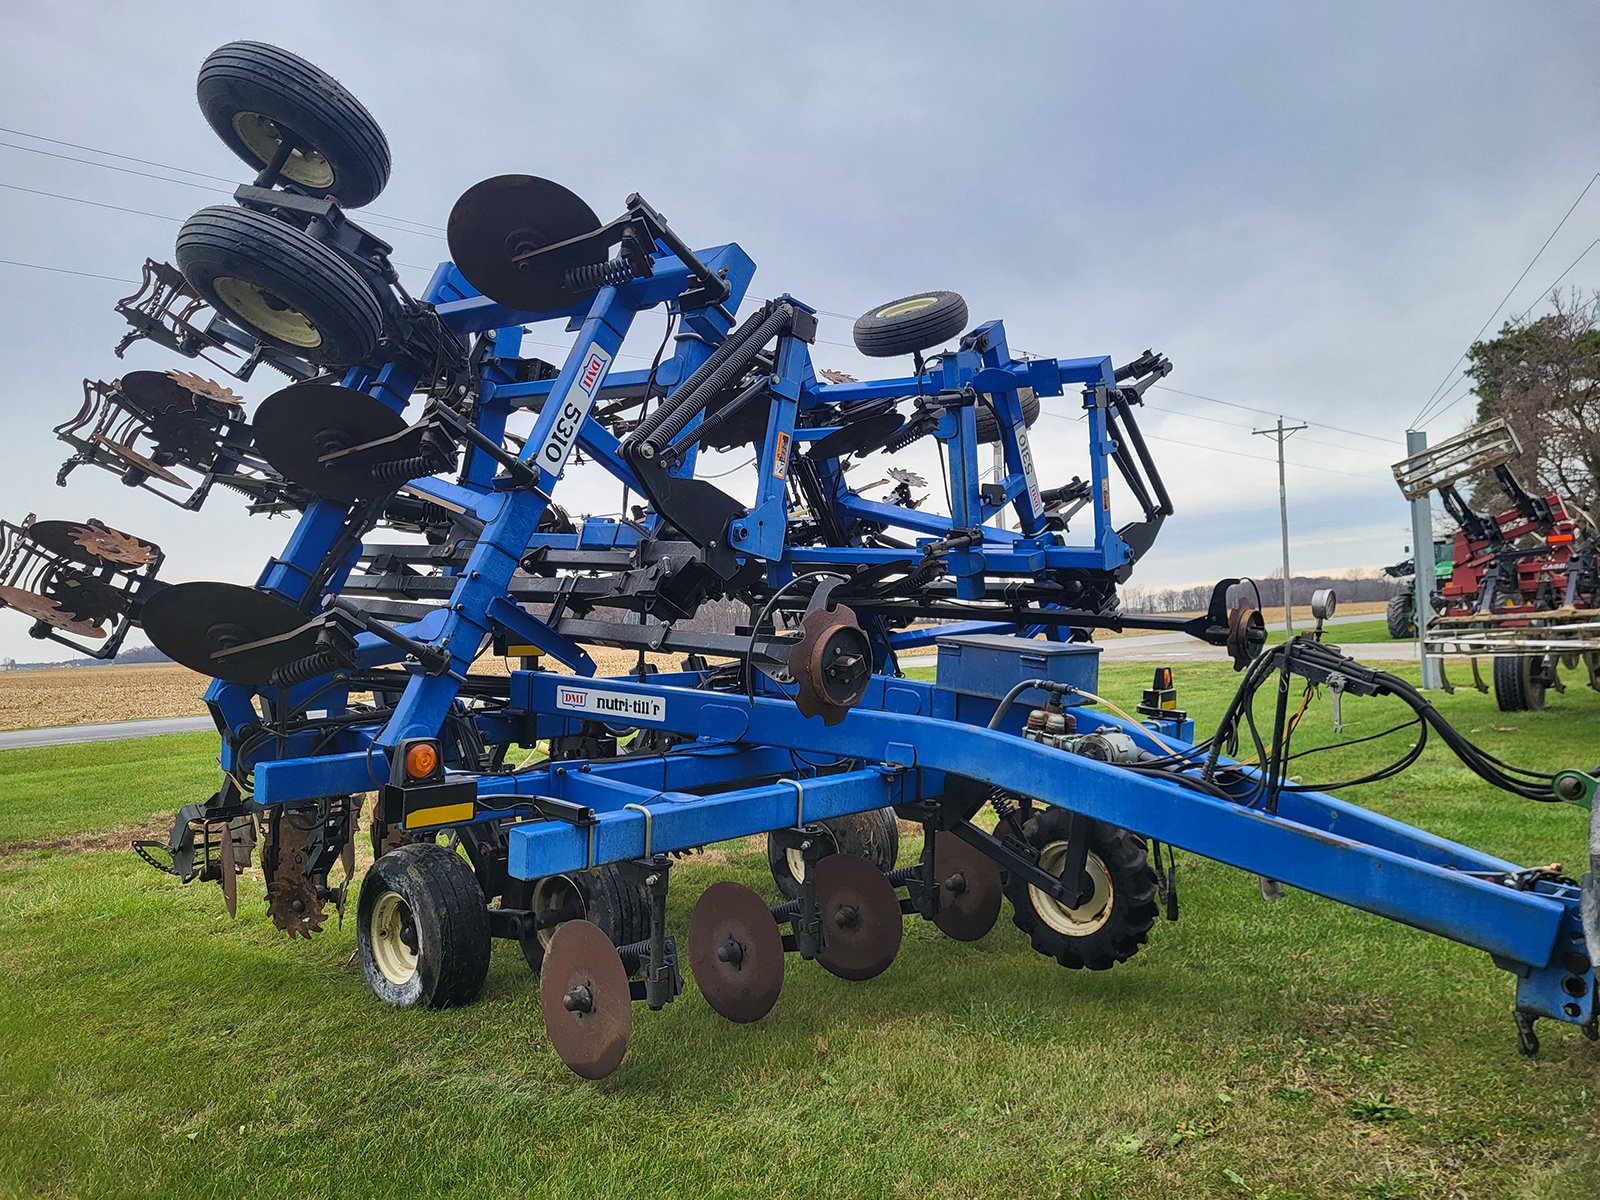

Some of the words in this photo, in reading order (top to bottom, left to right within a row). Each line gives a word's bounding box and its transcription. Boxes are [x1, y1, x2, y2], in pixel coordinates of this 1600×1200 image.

[583, 359, 601, 389] DMI
[545, 402, 582, 463] 5310
[1018, 434, 1033, 475] 5310
[1031, 489, 1039, 508] DMI
[565, 693, 583, 704] DMI
[596, 697, 660, 716] nutri-till'r
